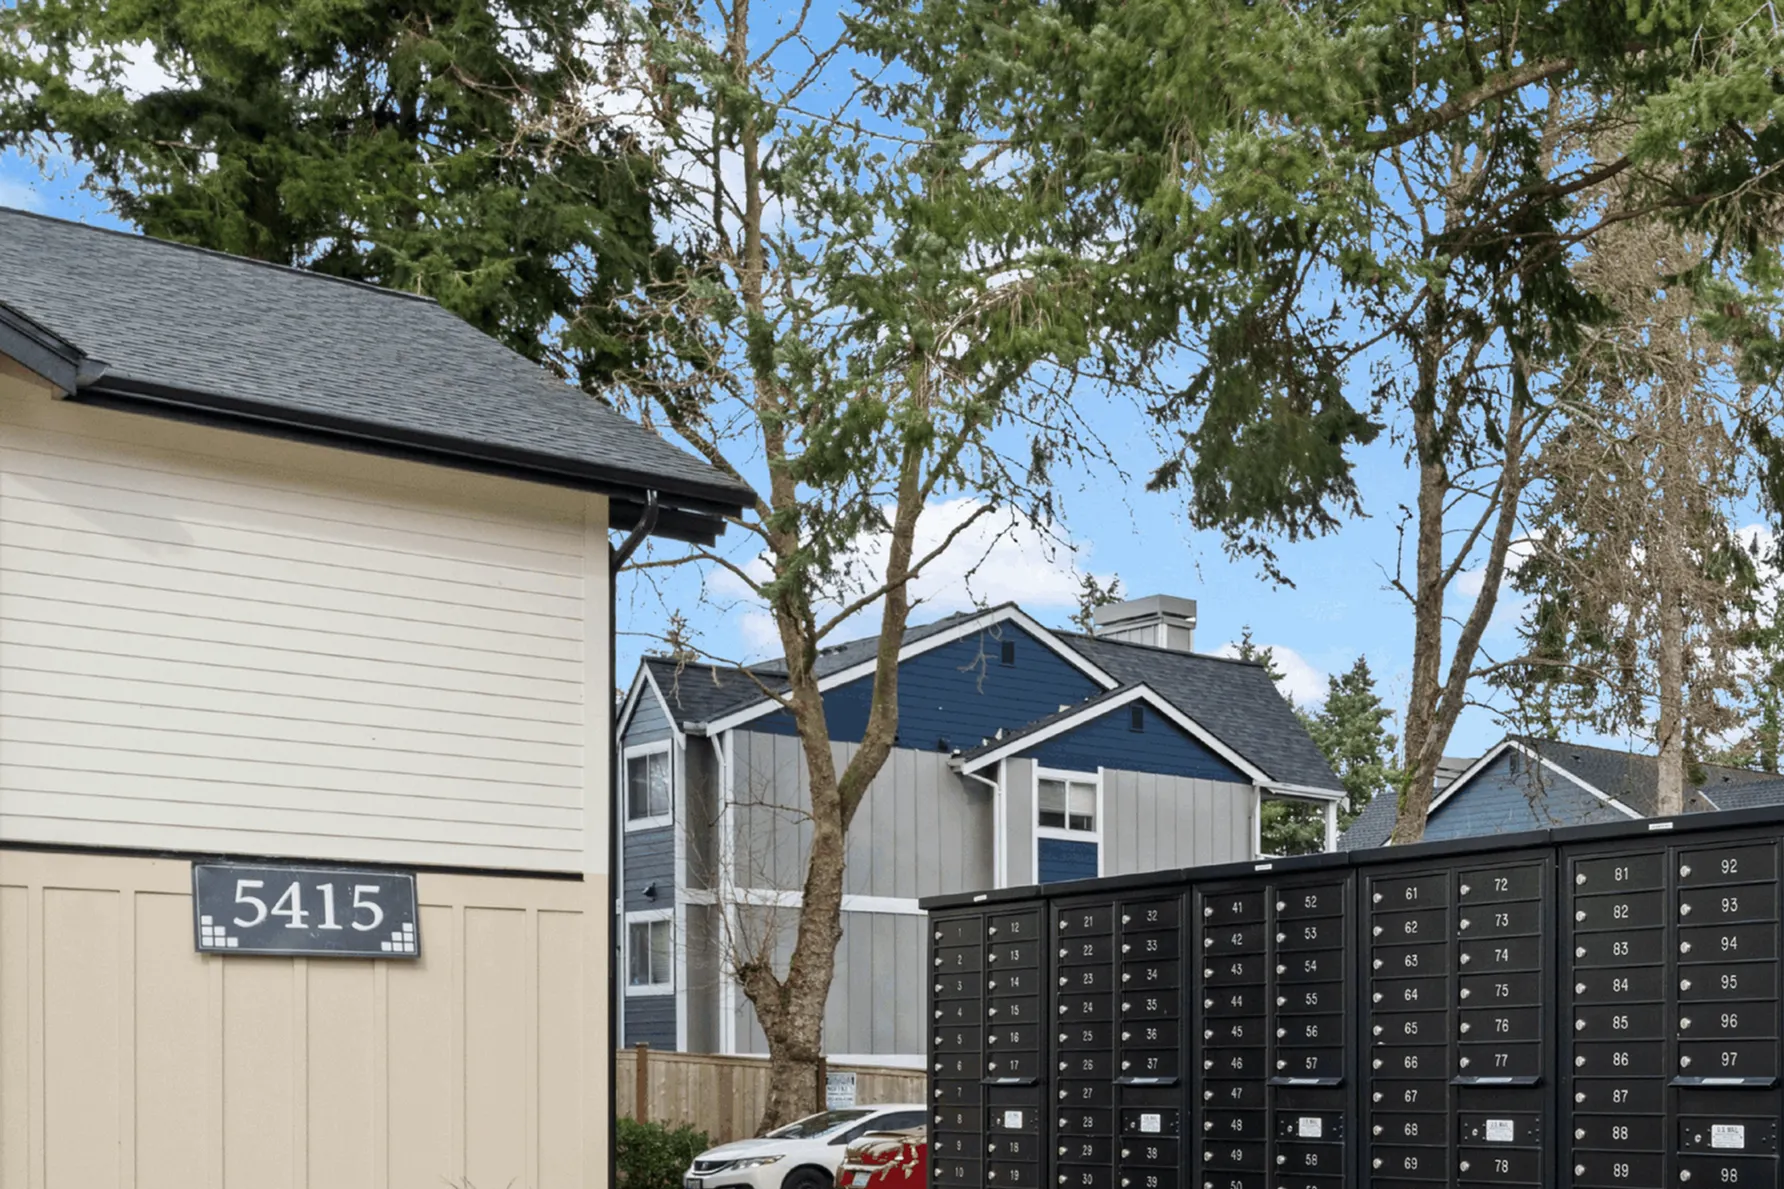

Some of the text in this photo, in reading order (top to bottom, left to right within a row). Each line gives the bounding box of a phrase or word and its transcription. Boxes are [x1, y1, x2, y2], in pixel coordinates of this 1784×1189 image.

[1721, 858, 1738, 874] 92
[1614, 866, 1629, 882] 81
[1494, 877, 1508, 892] 72
[1405, 886, 1418, 900] 61
[233, 879, 384, 931] 5415
[1231, 901, 1243, 913] 41
[1304, 895, 1317, 909] 52
[1721, 897, 1739, 913] 93
[1146, 909, 1158, 922] 32
[1613, 904, 1629, 919] 82
[1010, 921, 1020, 933] 12
[1083, 915, 1093, 928] 21
[1404, 920, 1418, 934] 62
[1495, 913, 1509, 927] 73
[1612, 941, 1629, 956] 83
[1720, 936, 1738, 952] 94
[1404, 954, 1419, 967] 63
[1494, 948, 1509, 962] 74
[1230, 962, 1243, 976] 43
[1304, 959, 1317, 973] 54
[1010, 976, 1020, 987] 14
[1083, 972, 1094, 985] 23
[1146, 968, 1158, 981] 34
[1612, 978, 1629, 993] 84
[1720, 974, 1738, 990] 95
[1404, 988, 1418, 1001] 64
[1495, 983, 1509, 997] 75
[1305, 992, 1318, 1006] 55
[1404, 1021, 1418, 1035] 65
[1495, 1018, 1509, 1033] 76
[1612, 1015, 1629, 1030] 85
[1720, 1013, 1738, 1029] 96
[1010, 1031, 1020, 1043] 16
[1082, 1058, 1094, 1071] 26
[1146, 1057, 1159, 1070] 37
[1230, 1056, 1243, 1070] 46
[1305, 1056, 1318, 1070] 57
[1404, 1055, 1418, 1069] 66
[1494, 1053, 1509, 1067] 77
[1612, 1051, 1629, 1067] 86
[1721, 1051, 1738, 1067] 97
[1404, 1089, 1418, 1103] 67
[1612, 1089, 1629, 1103] 87
[1404, 1122, 1418, 1136] 68
[1612, 1125, 1629, 1140] 88
[1082, 1144, 1093, 1156] 29
[1146, 1146, 1158, 1160] 38
[1230, 1148, 1243, 1161] 49
[1404, 1156, 1418, 1170] 69
[1494, 1159, 1509, 1174] 78
[1613, 1163, 1629, 1178] 89
[1720, 1167, 1738, 1183] 98
